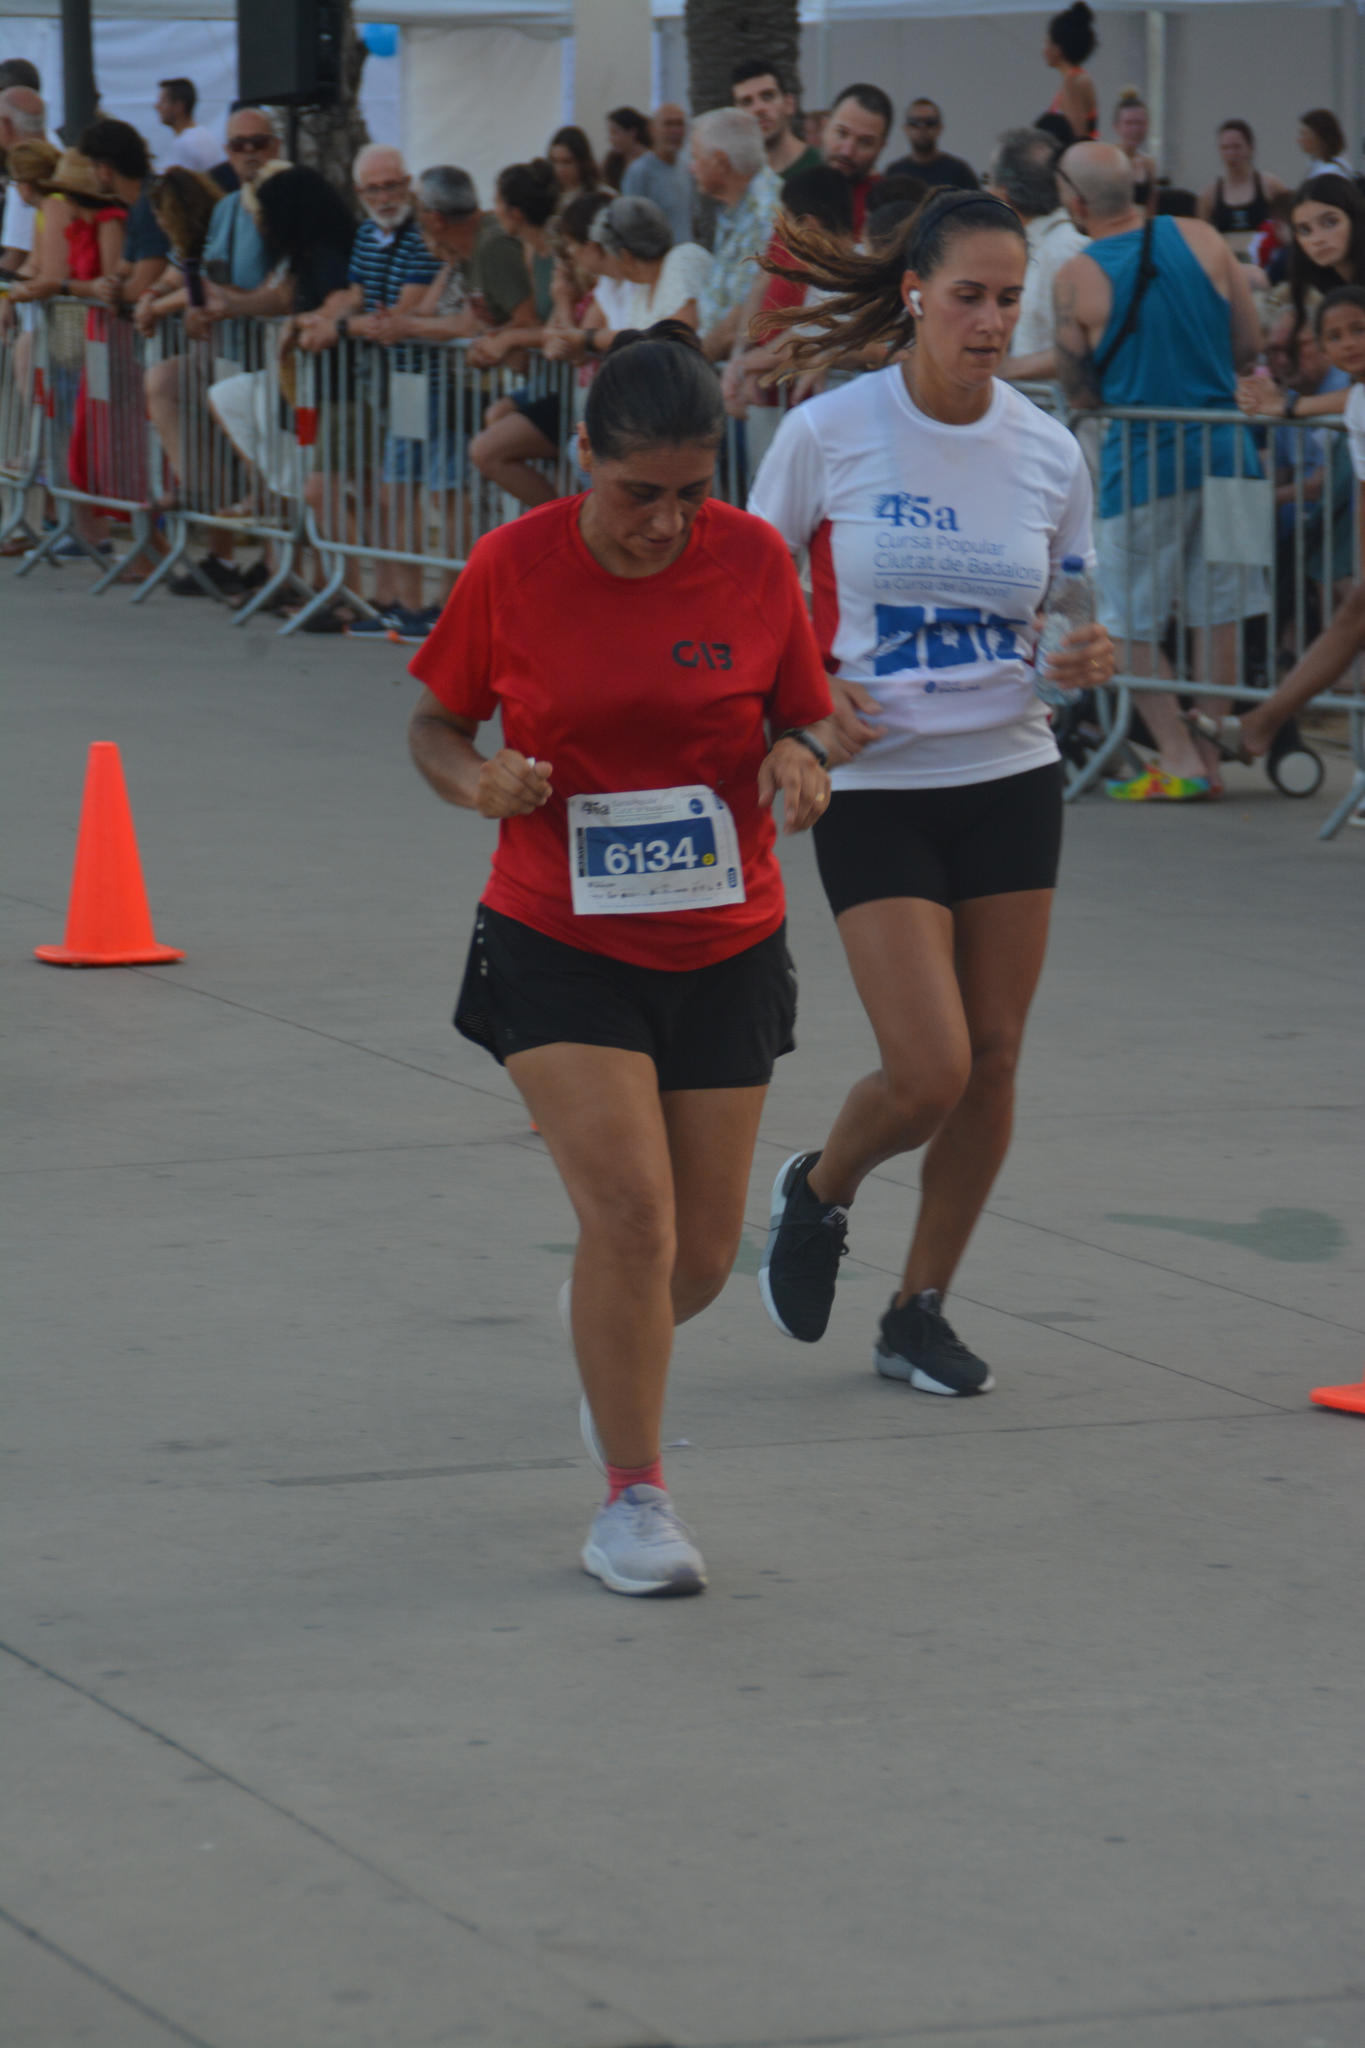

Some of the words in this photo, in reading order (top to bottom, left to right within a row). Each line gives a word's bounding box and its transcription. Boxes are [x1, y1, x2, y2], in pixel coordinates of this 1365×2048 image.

[873, 491, 960, 532] 45a
[875, 532, 932, 550] Cursa
[936, 536, 1006, 556] Popular
[873, 552, 936, 570] Ciutat
[939, 555, 964, 573] de
[967, 558, 1044, 582] Badalona
[604, 836, 699, 875] 6134
